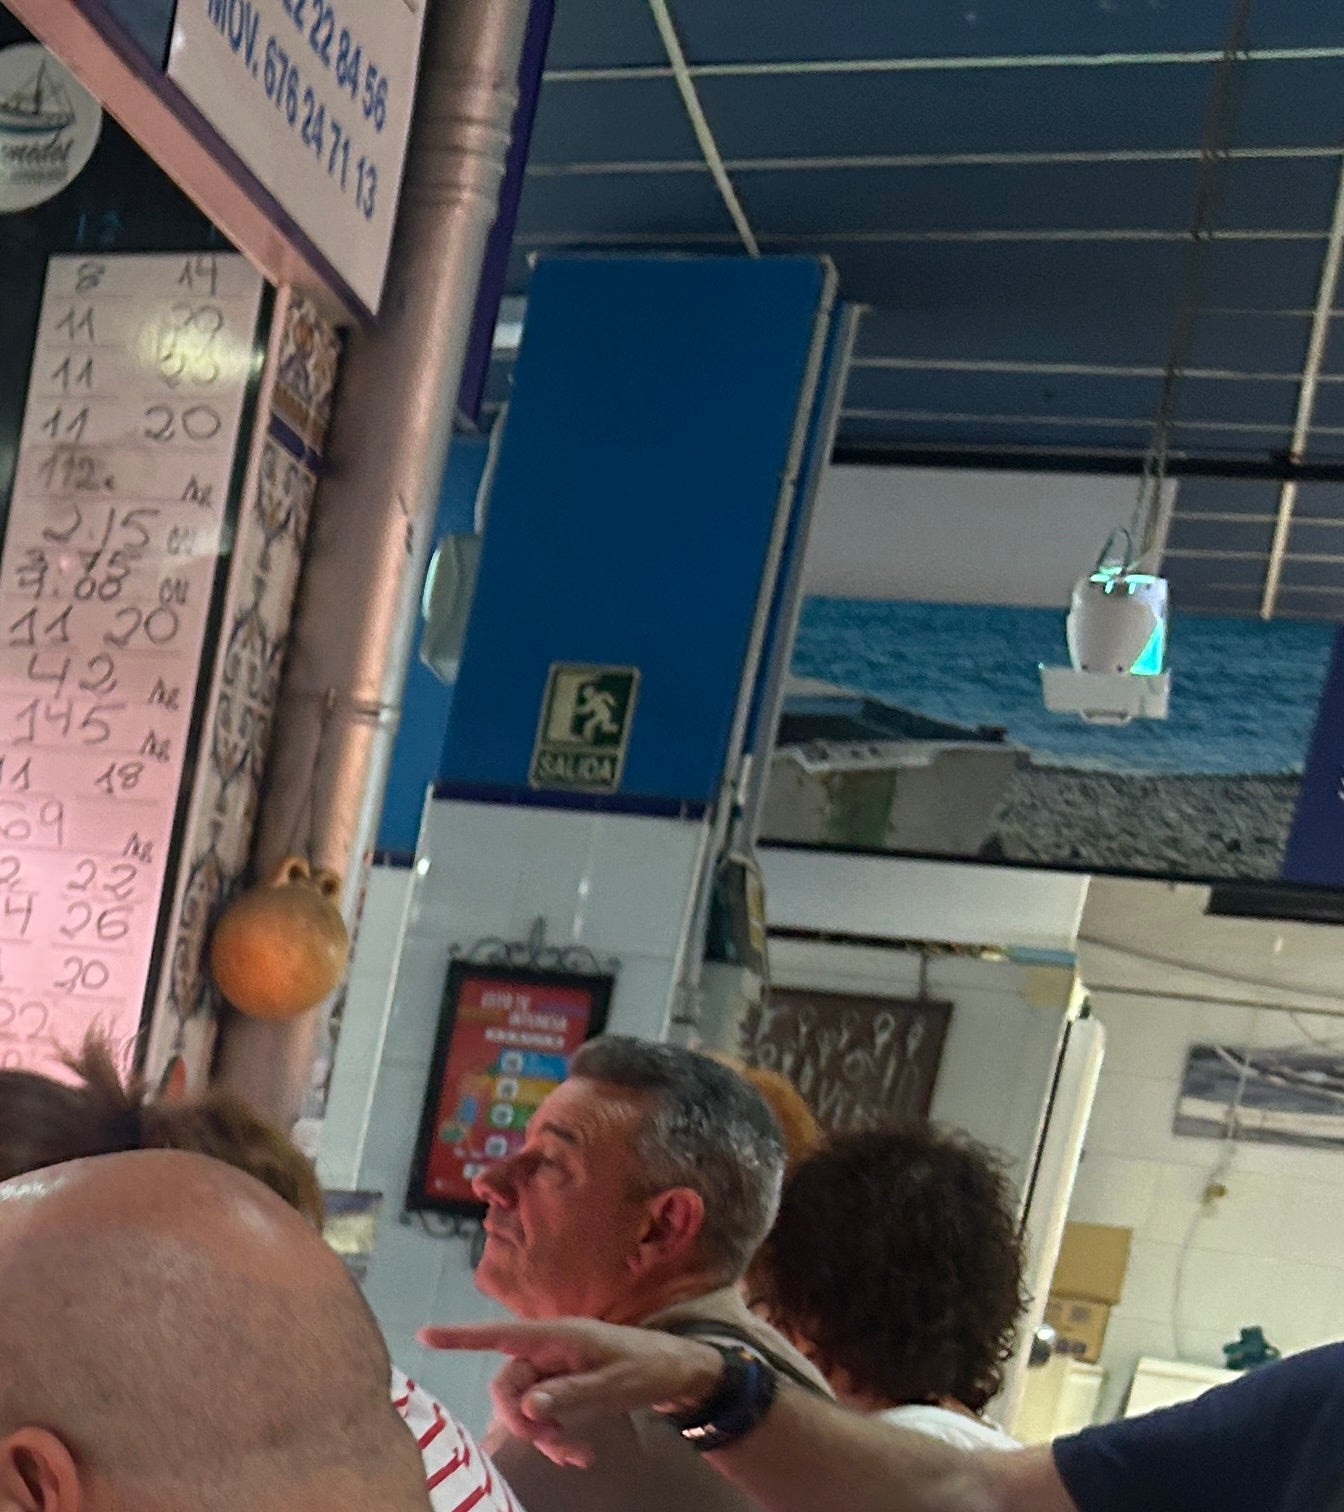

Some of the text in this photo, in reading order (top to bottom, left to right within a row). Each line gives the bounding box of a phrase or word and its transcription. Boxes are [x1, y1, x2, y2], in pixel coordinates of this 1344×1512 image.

[308, 0, 335, 67] 22
[335, 26, 362, 100] 84
[362, 61, 389, 134] 56
[301, 86, 325, 159] 24
[329, 118, 351, 194] 71
[356, 156, 377, 222] 13
[55, 306, 94, 340] 11
[52, 356, 93, 390] 11
[42, 404, 222, 442] 11 20
[10, 605, 178, 647] 11 20
[28, 653, 118, 700] 42
[15, 699, 127, 745] 145
[95, 762, 144, 794] 18
[536, 752, 615, 782] SALIDA
[67, 858, 138, 900] 22
[60, 901, 134, 940] 26
[53, 956, 110, 992] 20
